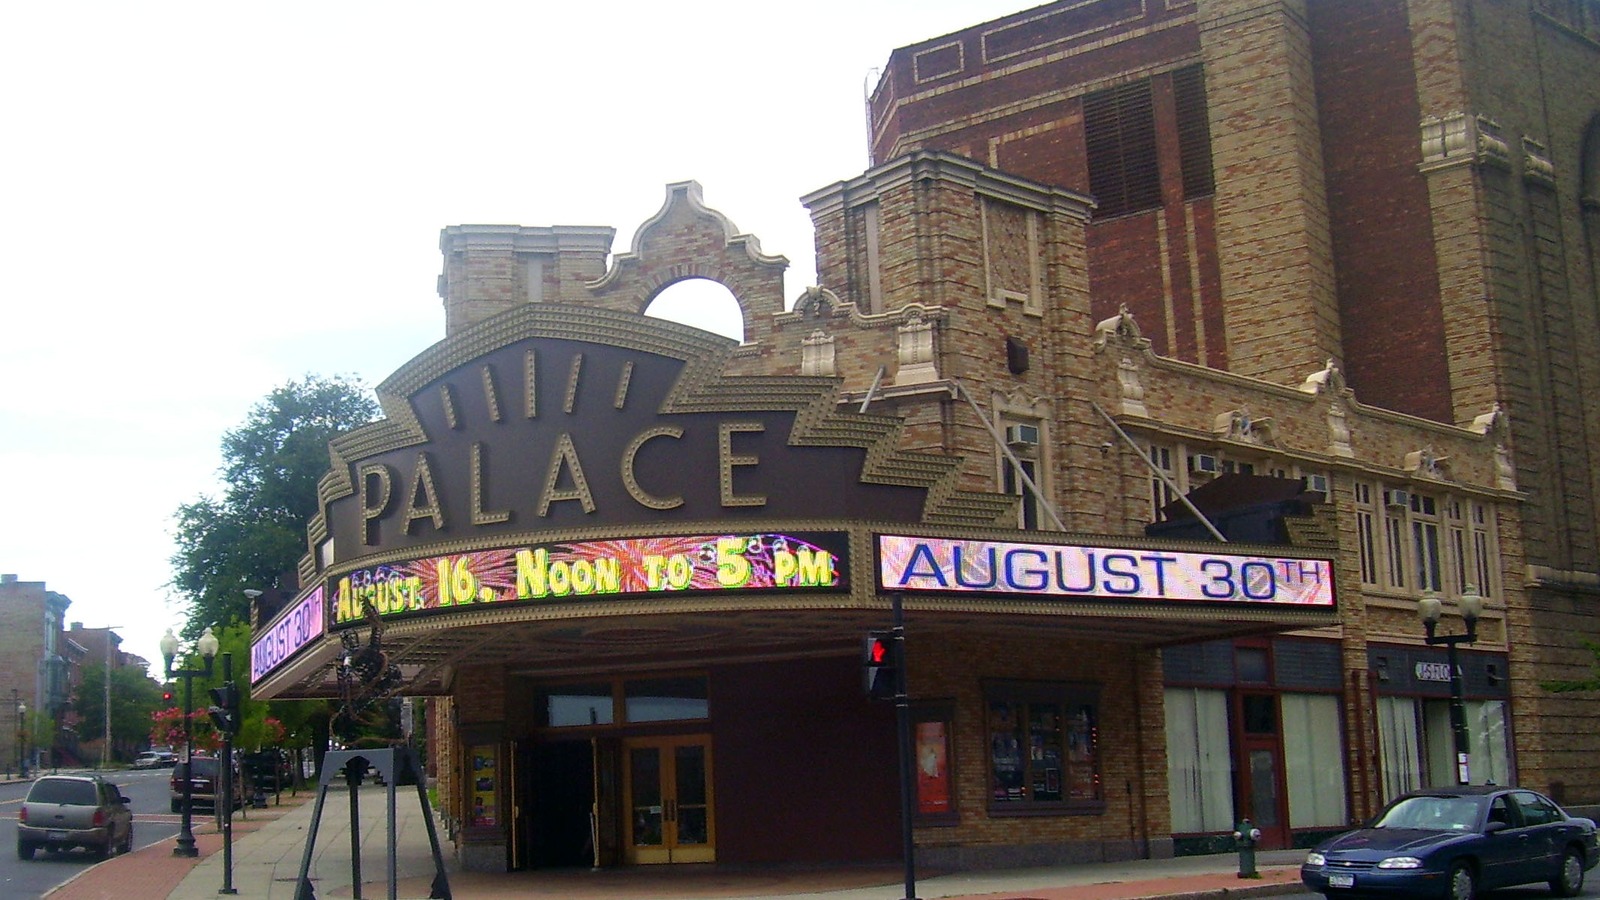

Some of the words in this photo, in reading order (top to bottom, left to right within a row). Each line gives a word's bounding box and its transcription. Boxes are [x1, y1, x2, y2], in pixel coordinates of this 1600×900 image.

[360, 421, 767, 546] PALACE
[516, 548, 620, 599] NOON
[644, 554, 692, 591] TO
[716, 537, 751, 588] 5
[774, 549, 833, 587] PM
[899, 542, 1179, 597] AUGUST
[1200, 558, 1322, 600] 30TH
[254, 617, 291, 680] AUGUST
